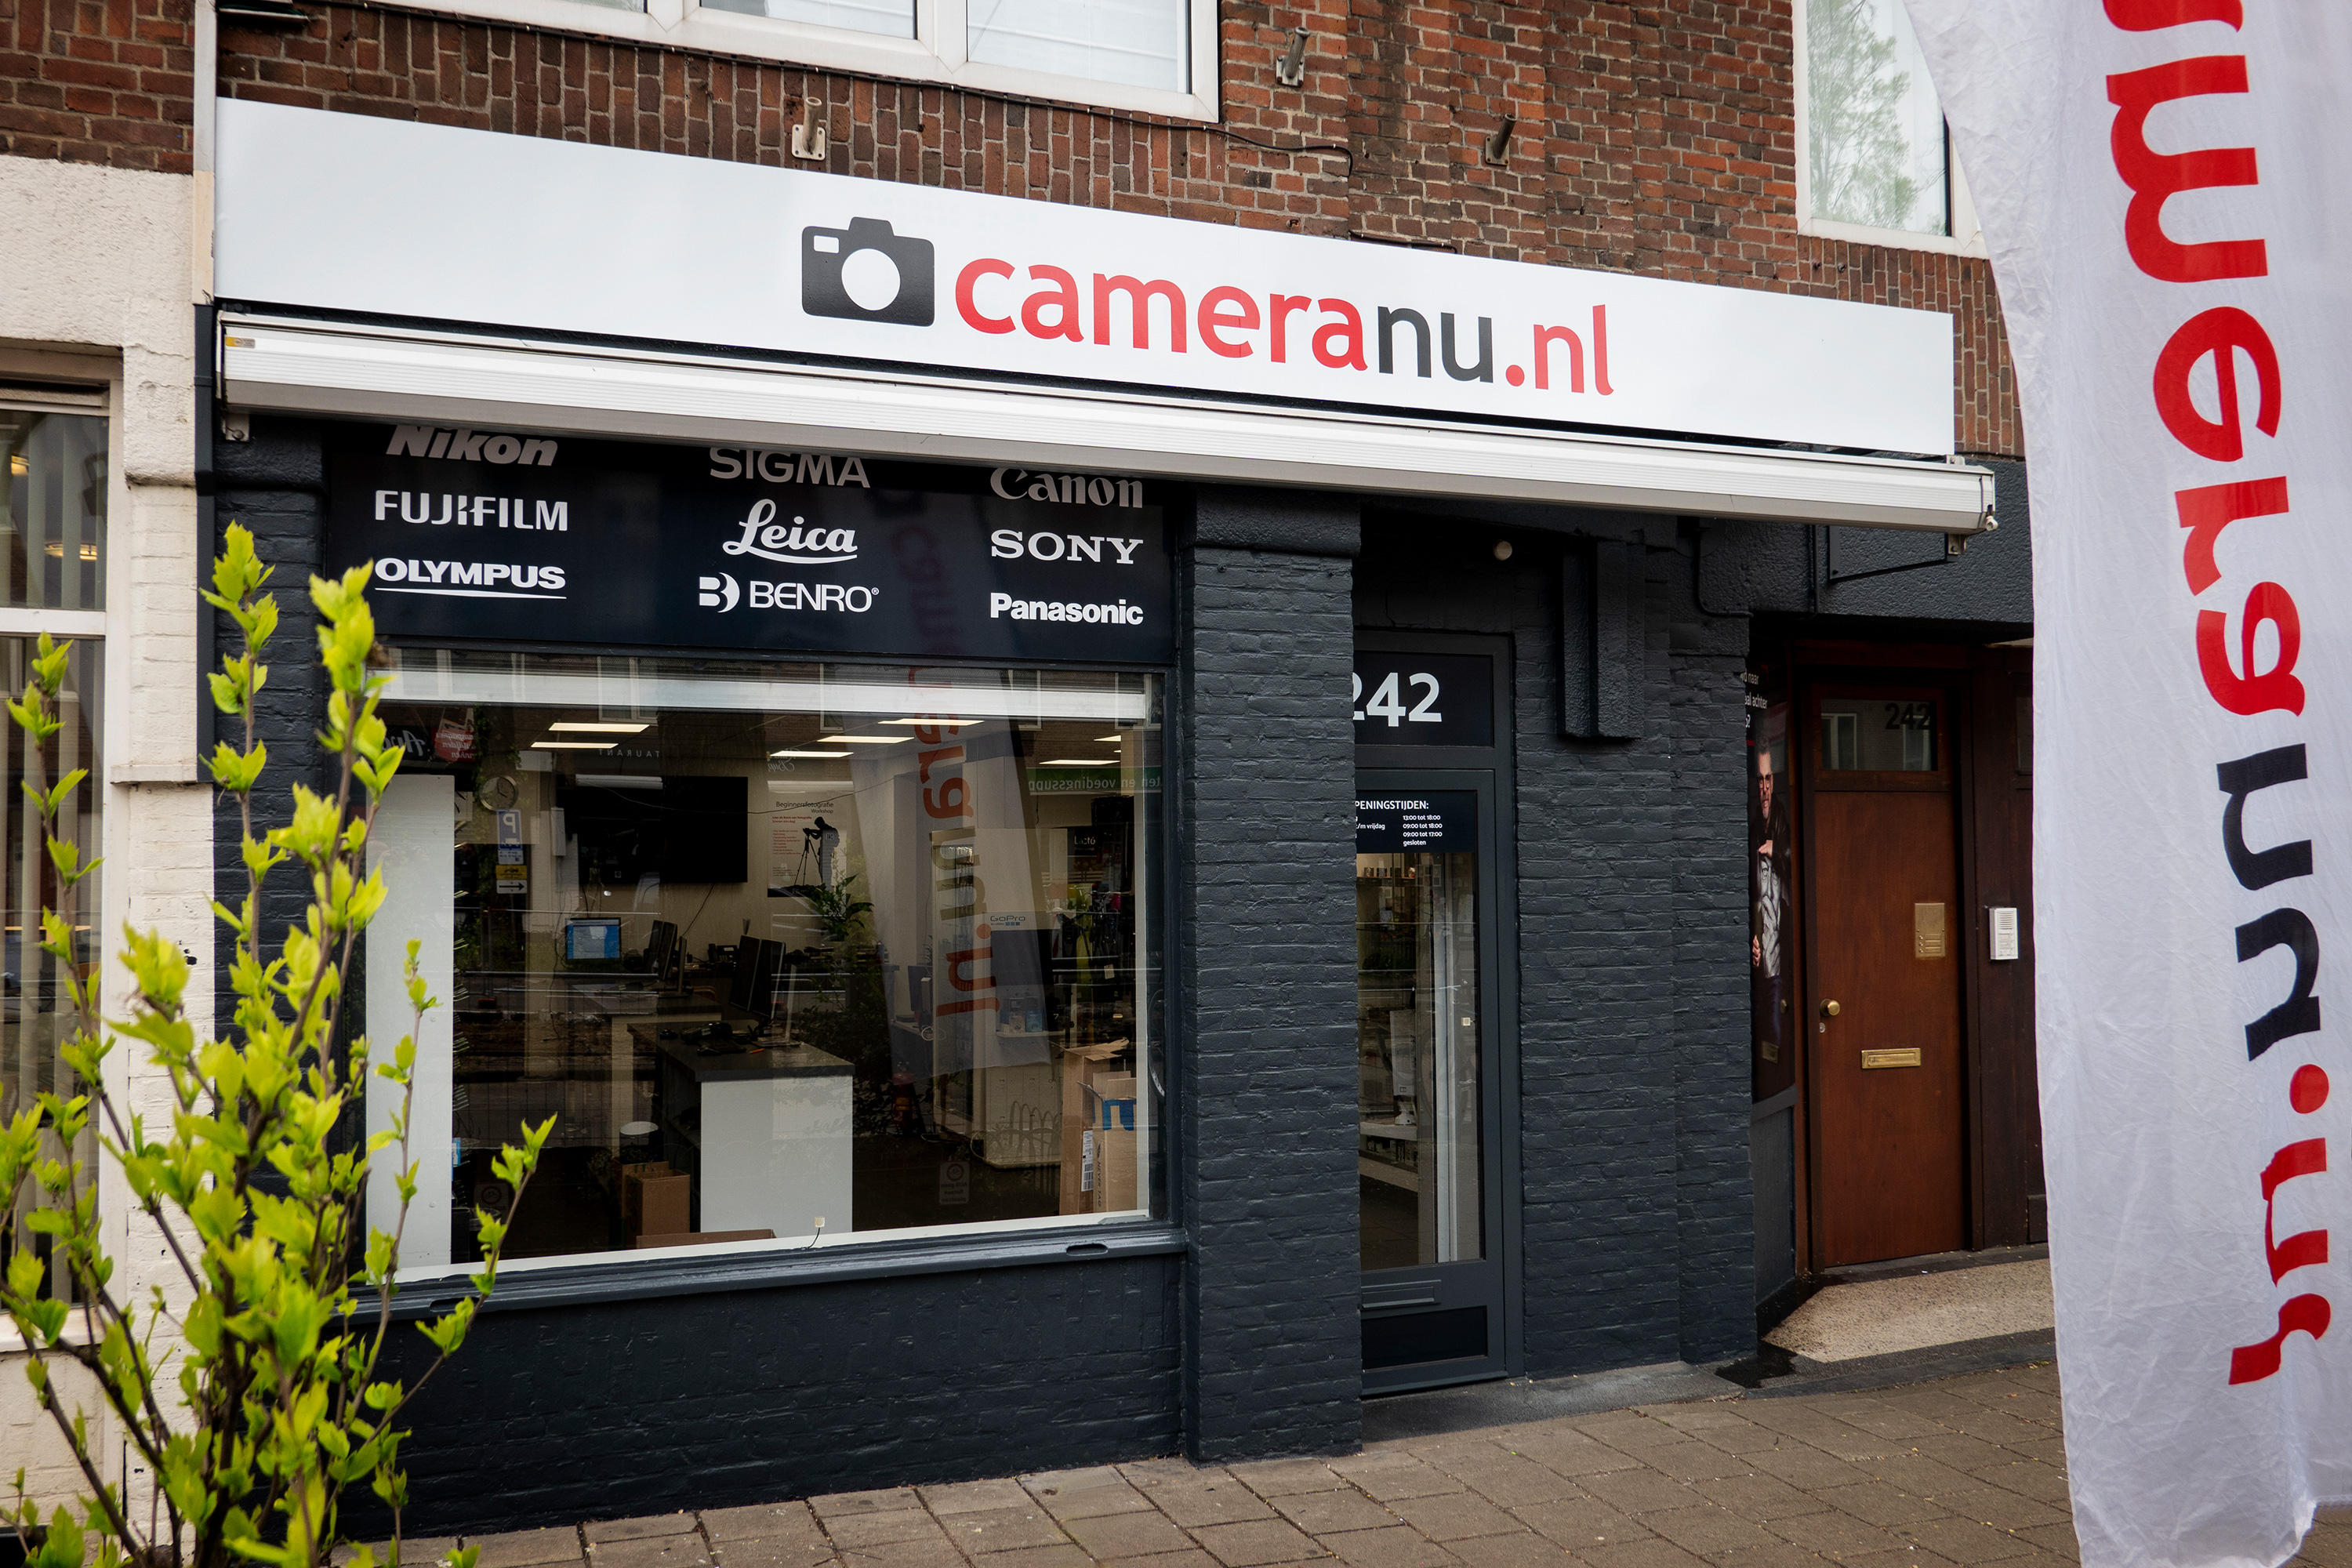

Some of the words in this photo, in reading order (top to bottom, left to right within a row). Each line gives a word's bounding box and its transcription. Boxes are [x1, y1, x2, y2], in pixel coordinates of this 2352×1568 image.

[955, 257, 1613, 397] cameranu.nl
[385, 424, 558, 466] Nikon
[709, 448, 871, 488] SIGMA
[989, 467, 1144, 509] Canon
[374, 490, 568, 532] FUJIFILM
[722, 499, 858, 564] Leica
[990, 529, 1144, 565] SONY
[374, 557, 566, 590] OLYMPUS
[989, 593, 1144, 626] Panasonic
[1885, 702, 1931, 730] 242
[1355, 800, 1429, 811] PENINGSTIJDEN:
